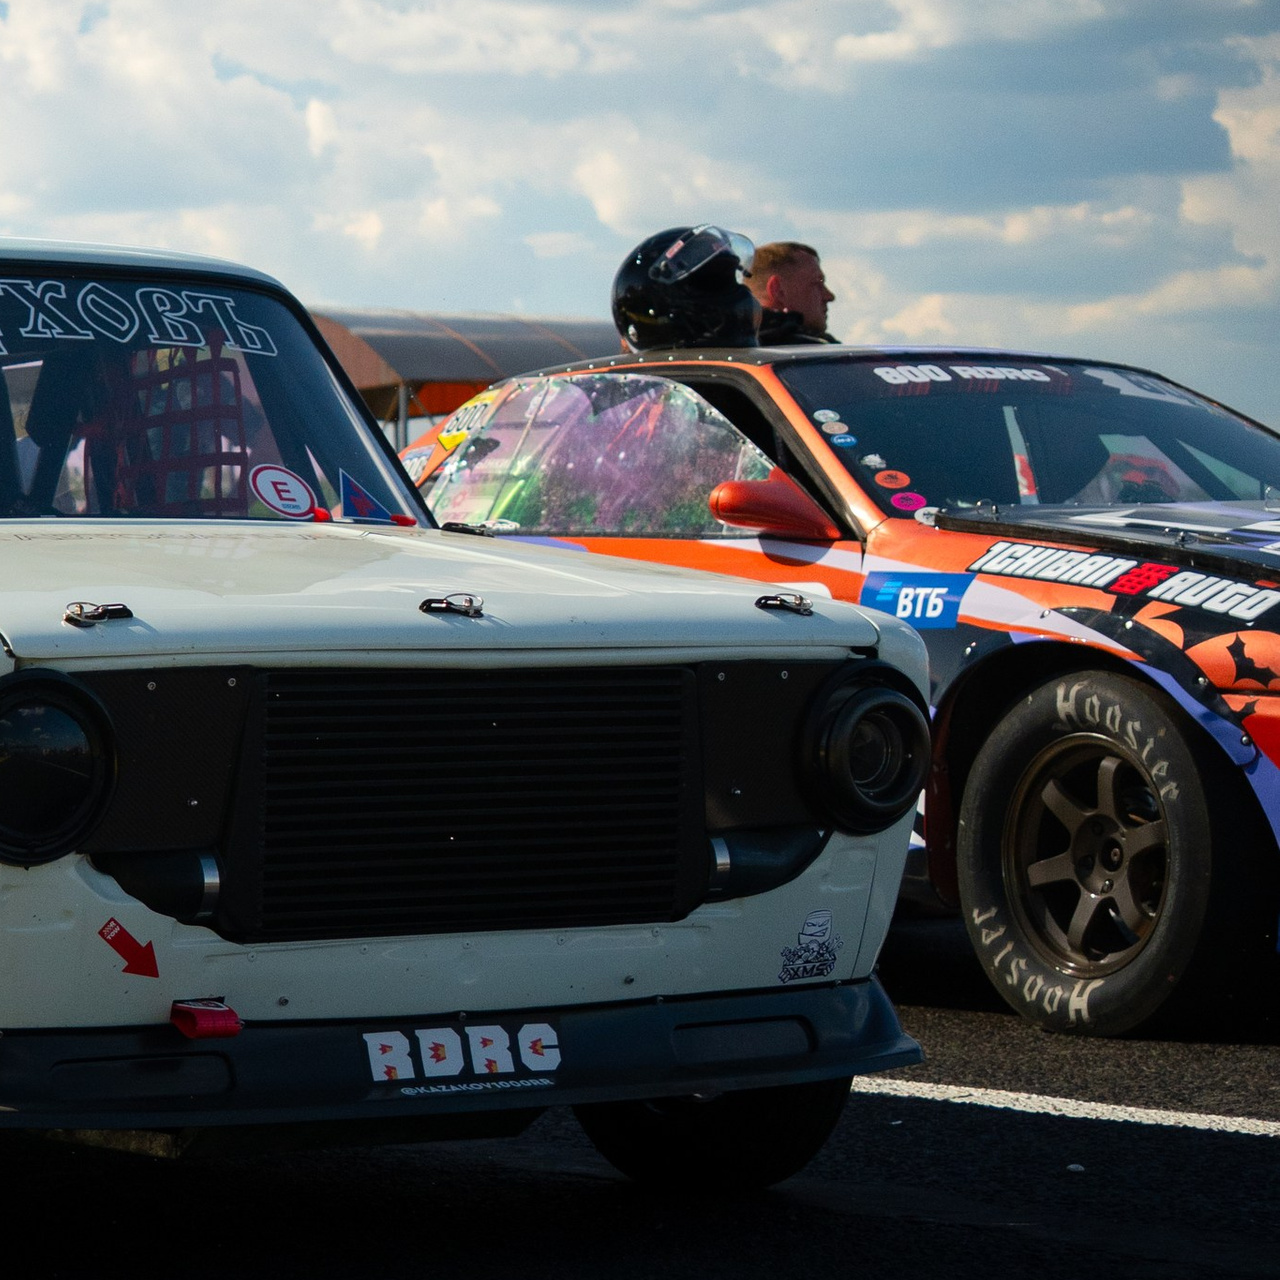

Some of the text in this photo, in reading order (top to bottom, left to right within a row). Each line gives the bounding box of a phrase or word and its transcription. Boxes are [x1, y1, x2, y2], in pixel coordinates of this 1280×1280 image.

[873, 363, 952, 384] 800
[270, 480, 297, 502] E
[896, 587, 949, 618] ВТБ
[1146, 571, 1280, 621] AUTO
[106, 925, 120, 940] TOW
[362, 1023, 562, 1082] RDRC
[400, 1077, 556, 1096] @KAZAKOV1000RR
